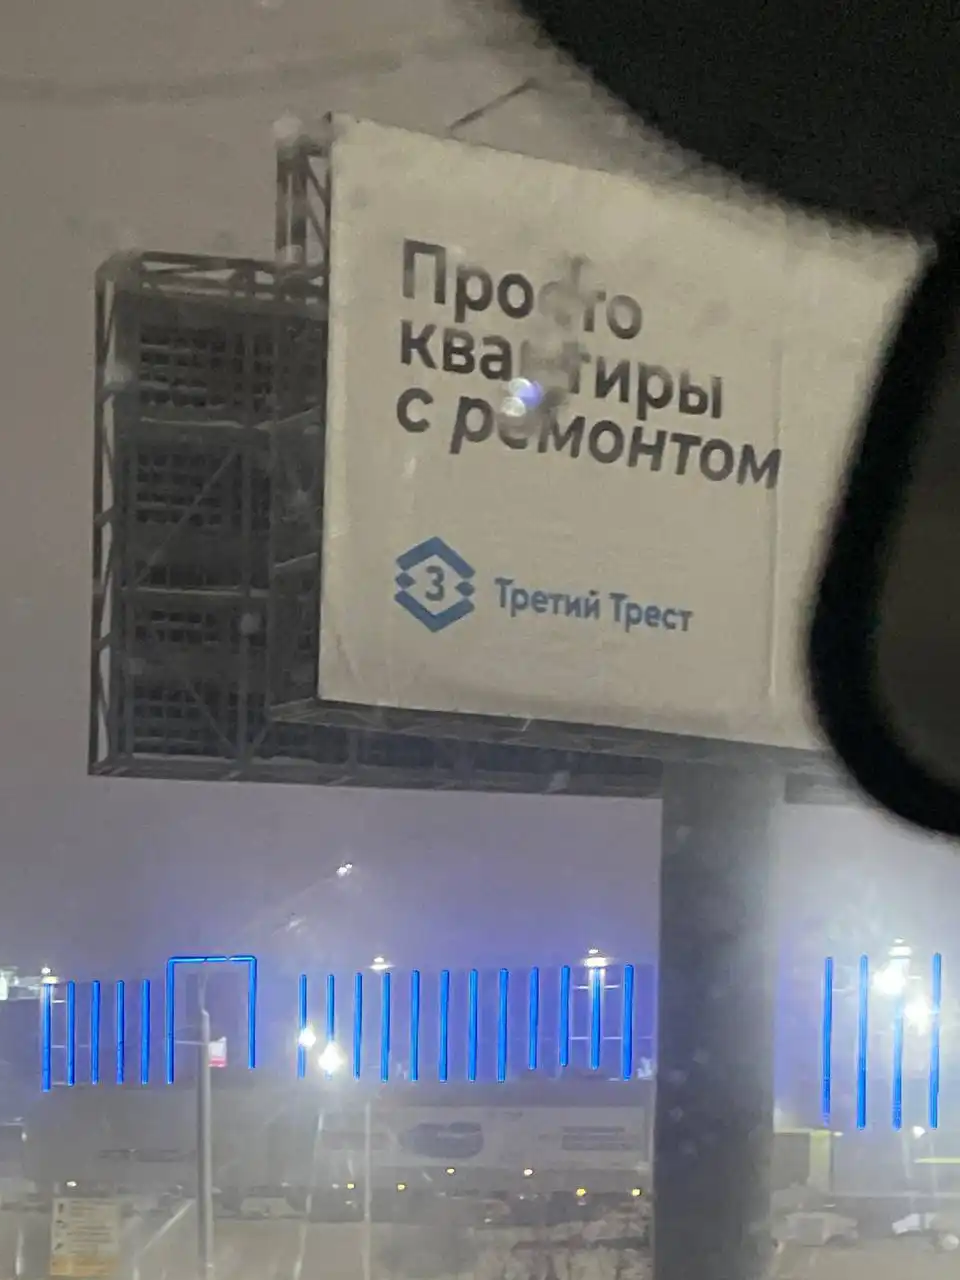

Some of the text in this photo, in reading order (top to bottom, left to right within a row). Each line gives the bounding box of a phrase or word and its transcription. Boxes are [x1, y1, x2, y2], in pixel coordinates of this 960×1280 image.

[400, 319, 723, 421] кватиры
[396, 387, 782, 490] с ремонтом
[493, 576, 601, 619] Третий
[608, 591, 694, 632] Трест
